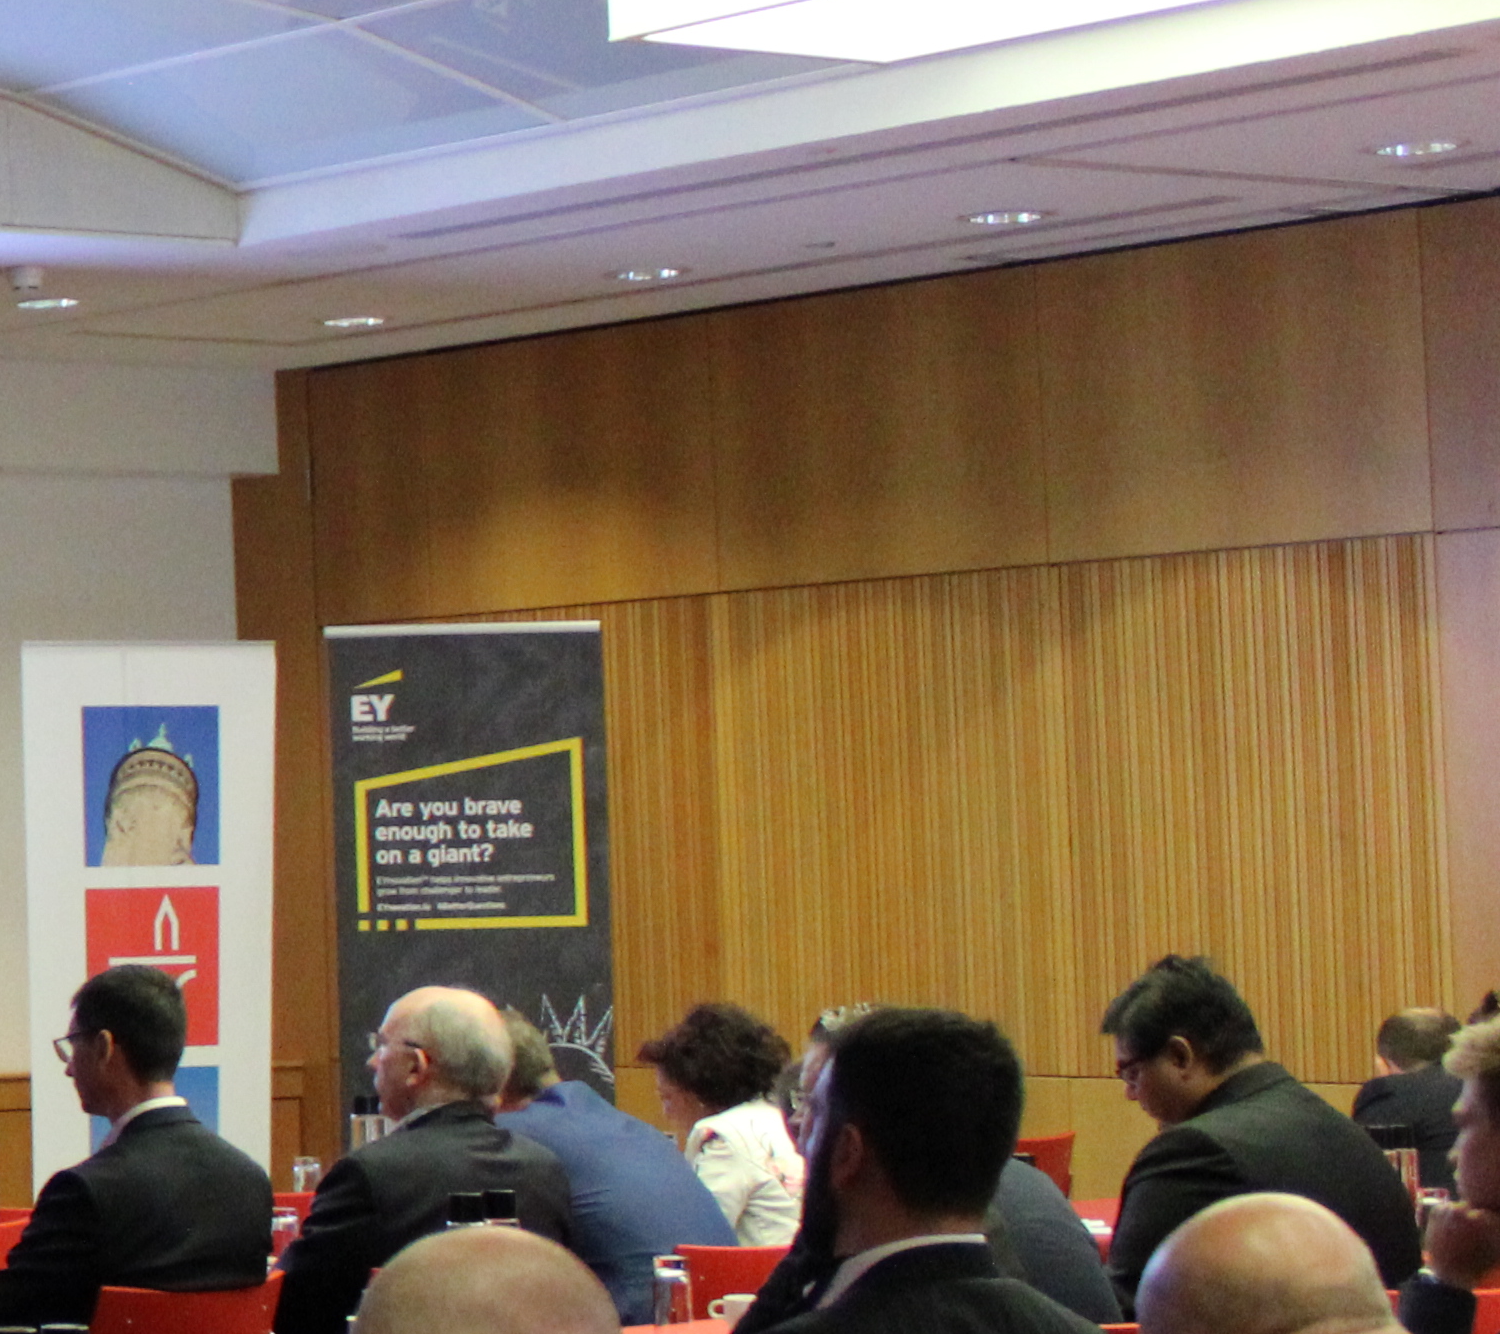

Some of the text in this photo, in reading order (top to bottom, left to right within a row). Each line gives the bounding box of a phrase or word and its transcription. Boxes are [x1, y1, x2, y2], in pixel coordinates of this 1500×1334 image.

[351, 694, 395, 722] EY
[375, 797, 523, 821] Are you brave
[375, 819, 534, 844] enough to take
[375, 844, 495, 868] on a giant?
